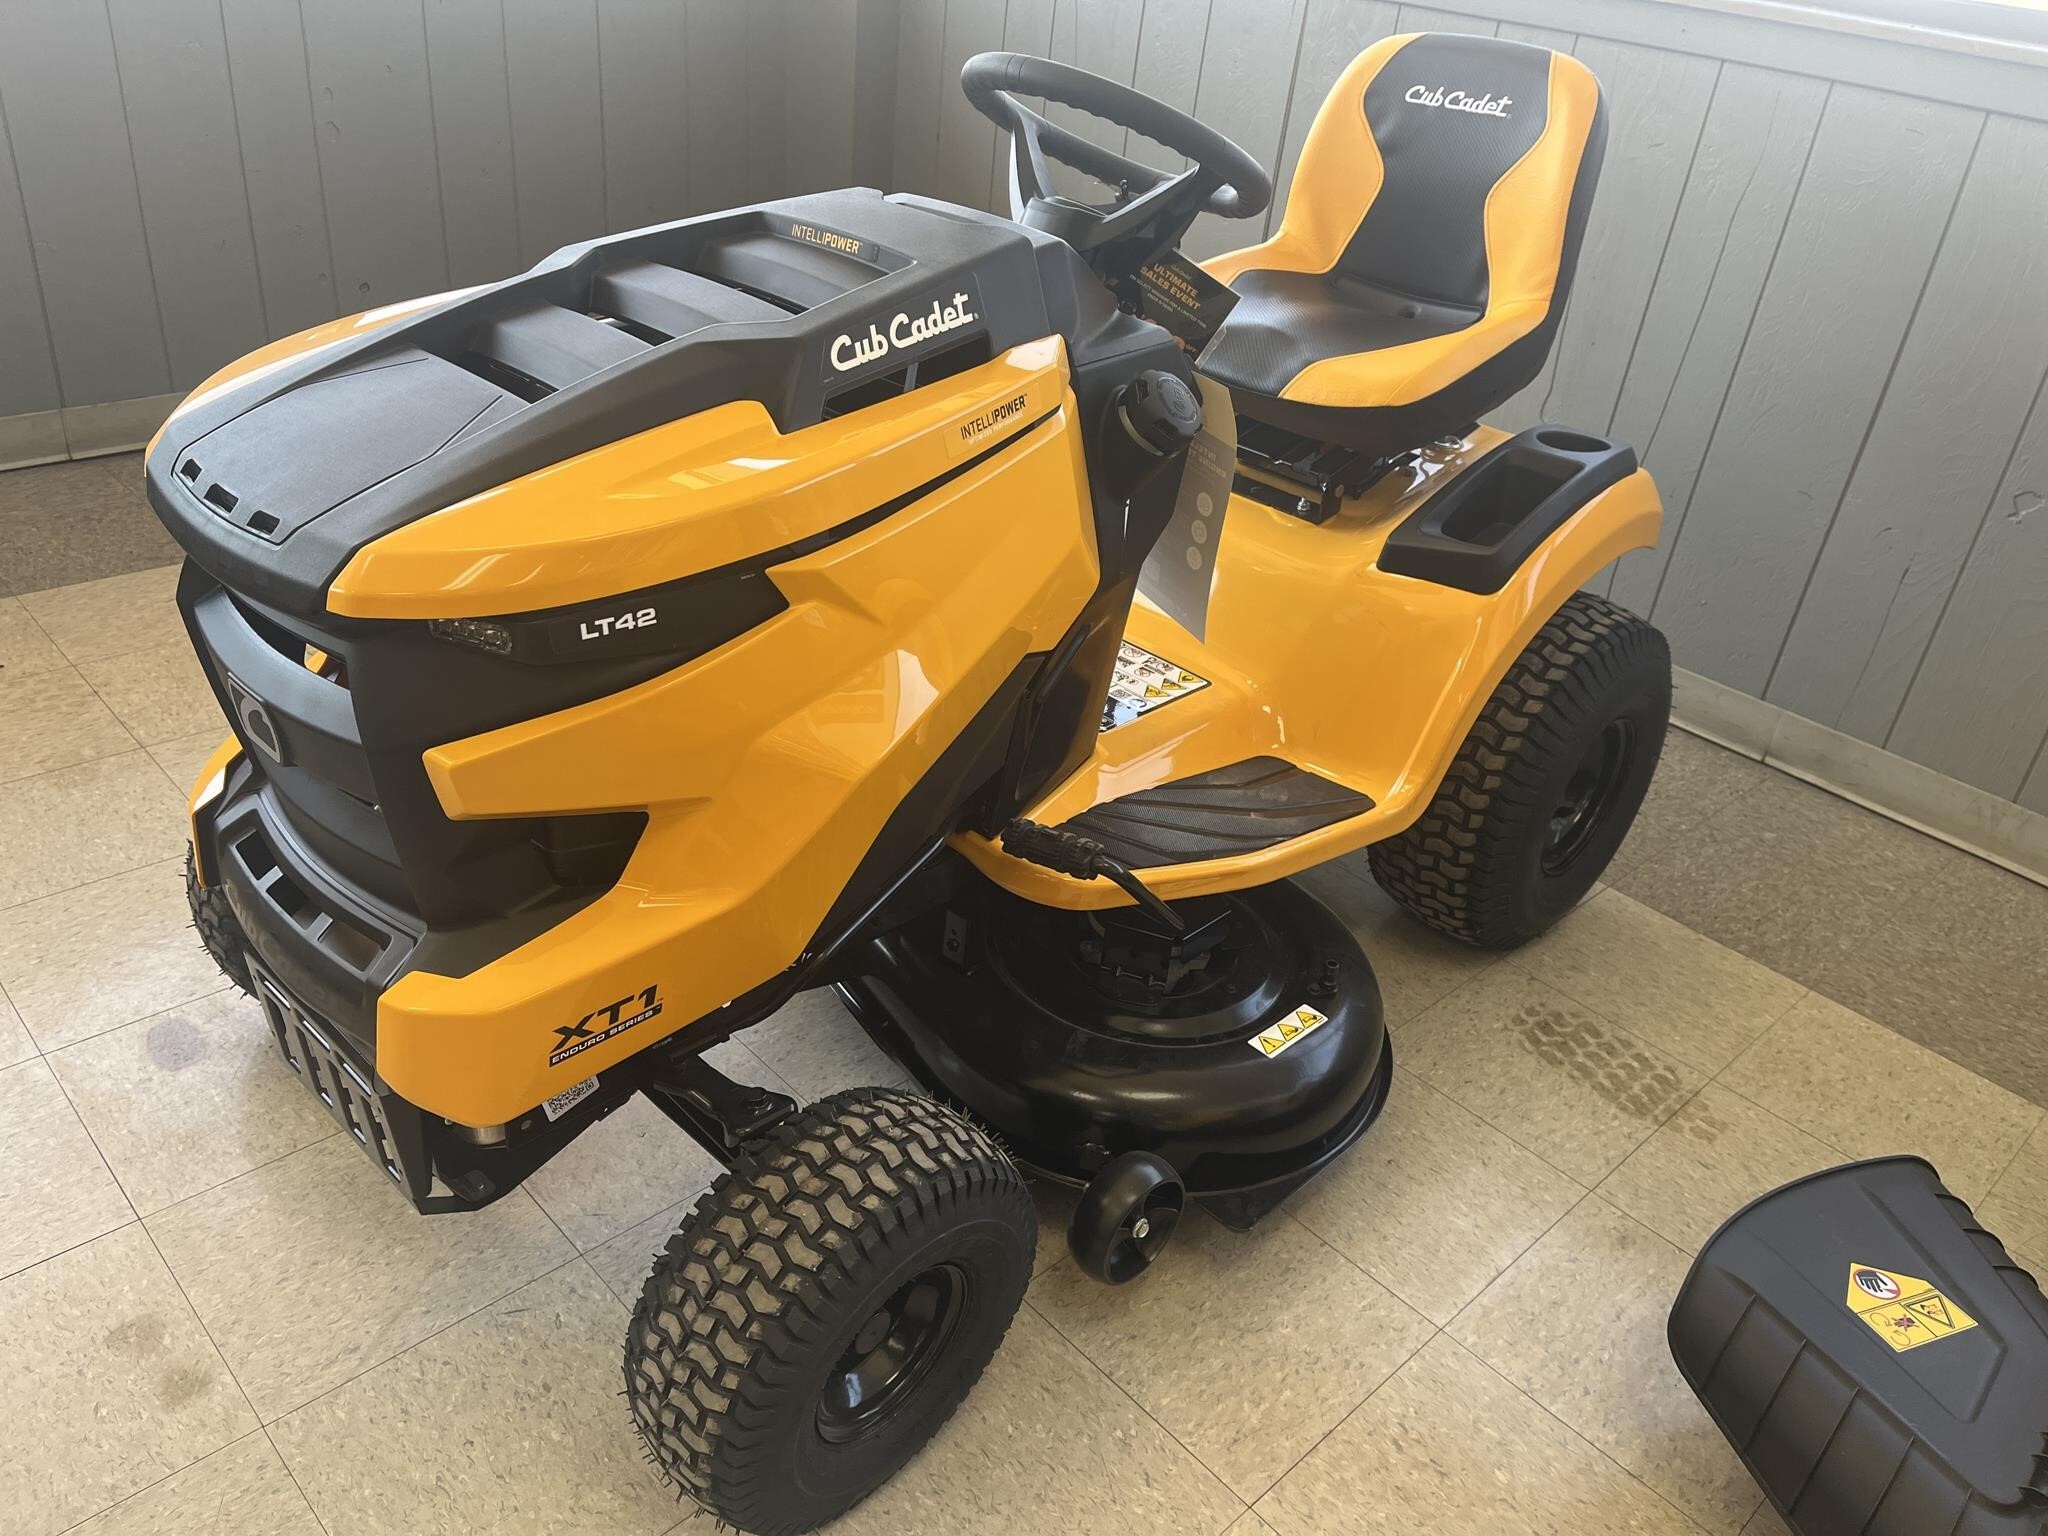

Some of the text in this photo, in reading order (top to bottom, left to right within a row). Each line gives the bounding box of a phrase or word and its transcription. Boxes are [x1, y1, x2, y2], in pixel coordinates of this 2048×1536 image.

[1405, 85, 1512, 118] Cub Cadet
[791, 223, 861, 254] INTELLIPOWER
[1140, 266, 1170, 291] SALES
[1169, 285, 1201, 310] EVENT
[1153, 263, 1200, 297] ULTIMATE
[830, 292, 974, 372] Cub Cadet
[960, 395, 1026, 440] INTELLIPOWER
[580, 607, 657, 641] LT42
[550, 984, 658, 1054] XT1
[552, 1010, 653, 1064] ENDURO SERIES
